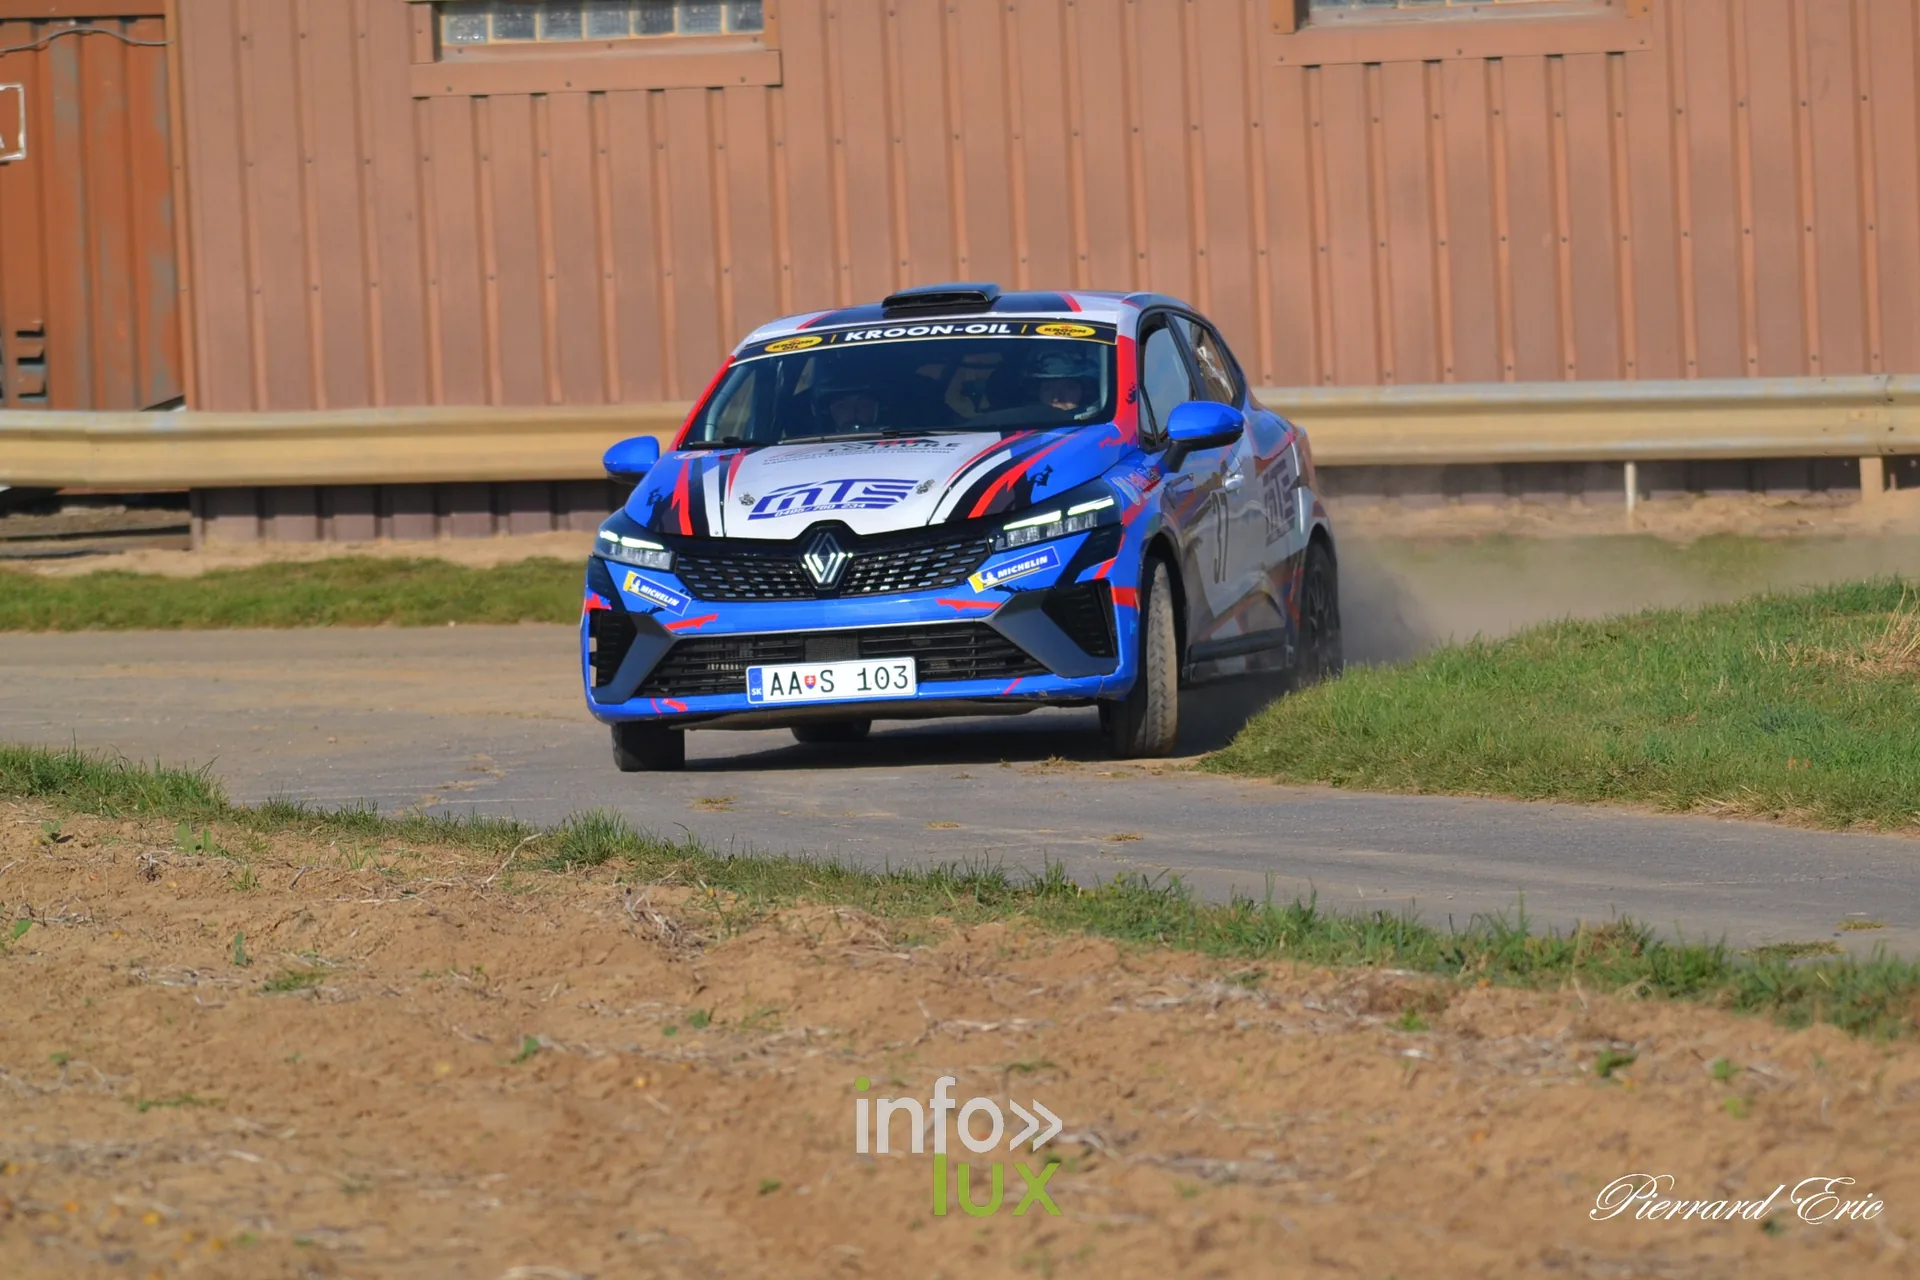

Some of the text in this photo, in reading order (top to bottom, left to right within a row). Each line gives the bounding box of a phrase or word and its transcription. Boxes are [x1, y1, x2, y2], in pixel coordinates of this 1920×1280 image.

[844, 324, 1011, 341] KROON-OIL
[997, 555, 1048, 579] MICHELIN
[640, 585, 680, 607] MICHELIN
[857, 665, 909, 692] 103
[751, 688, 762, 696] SK
